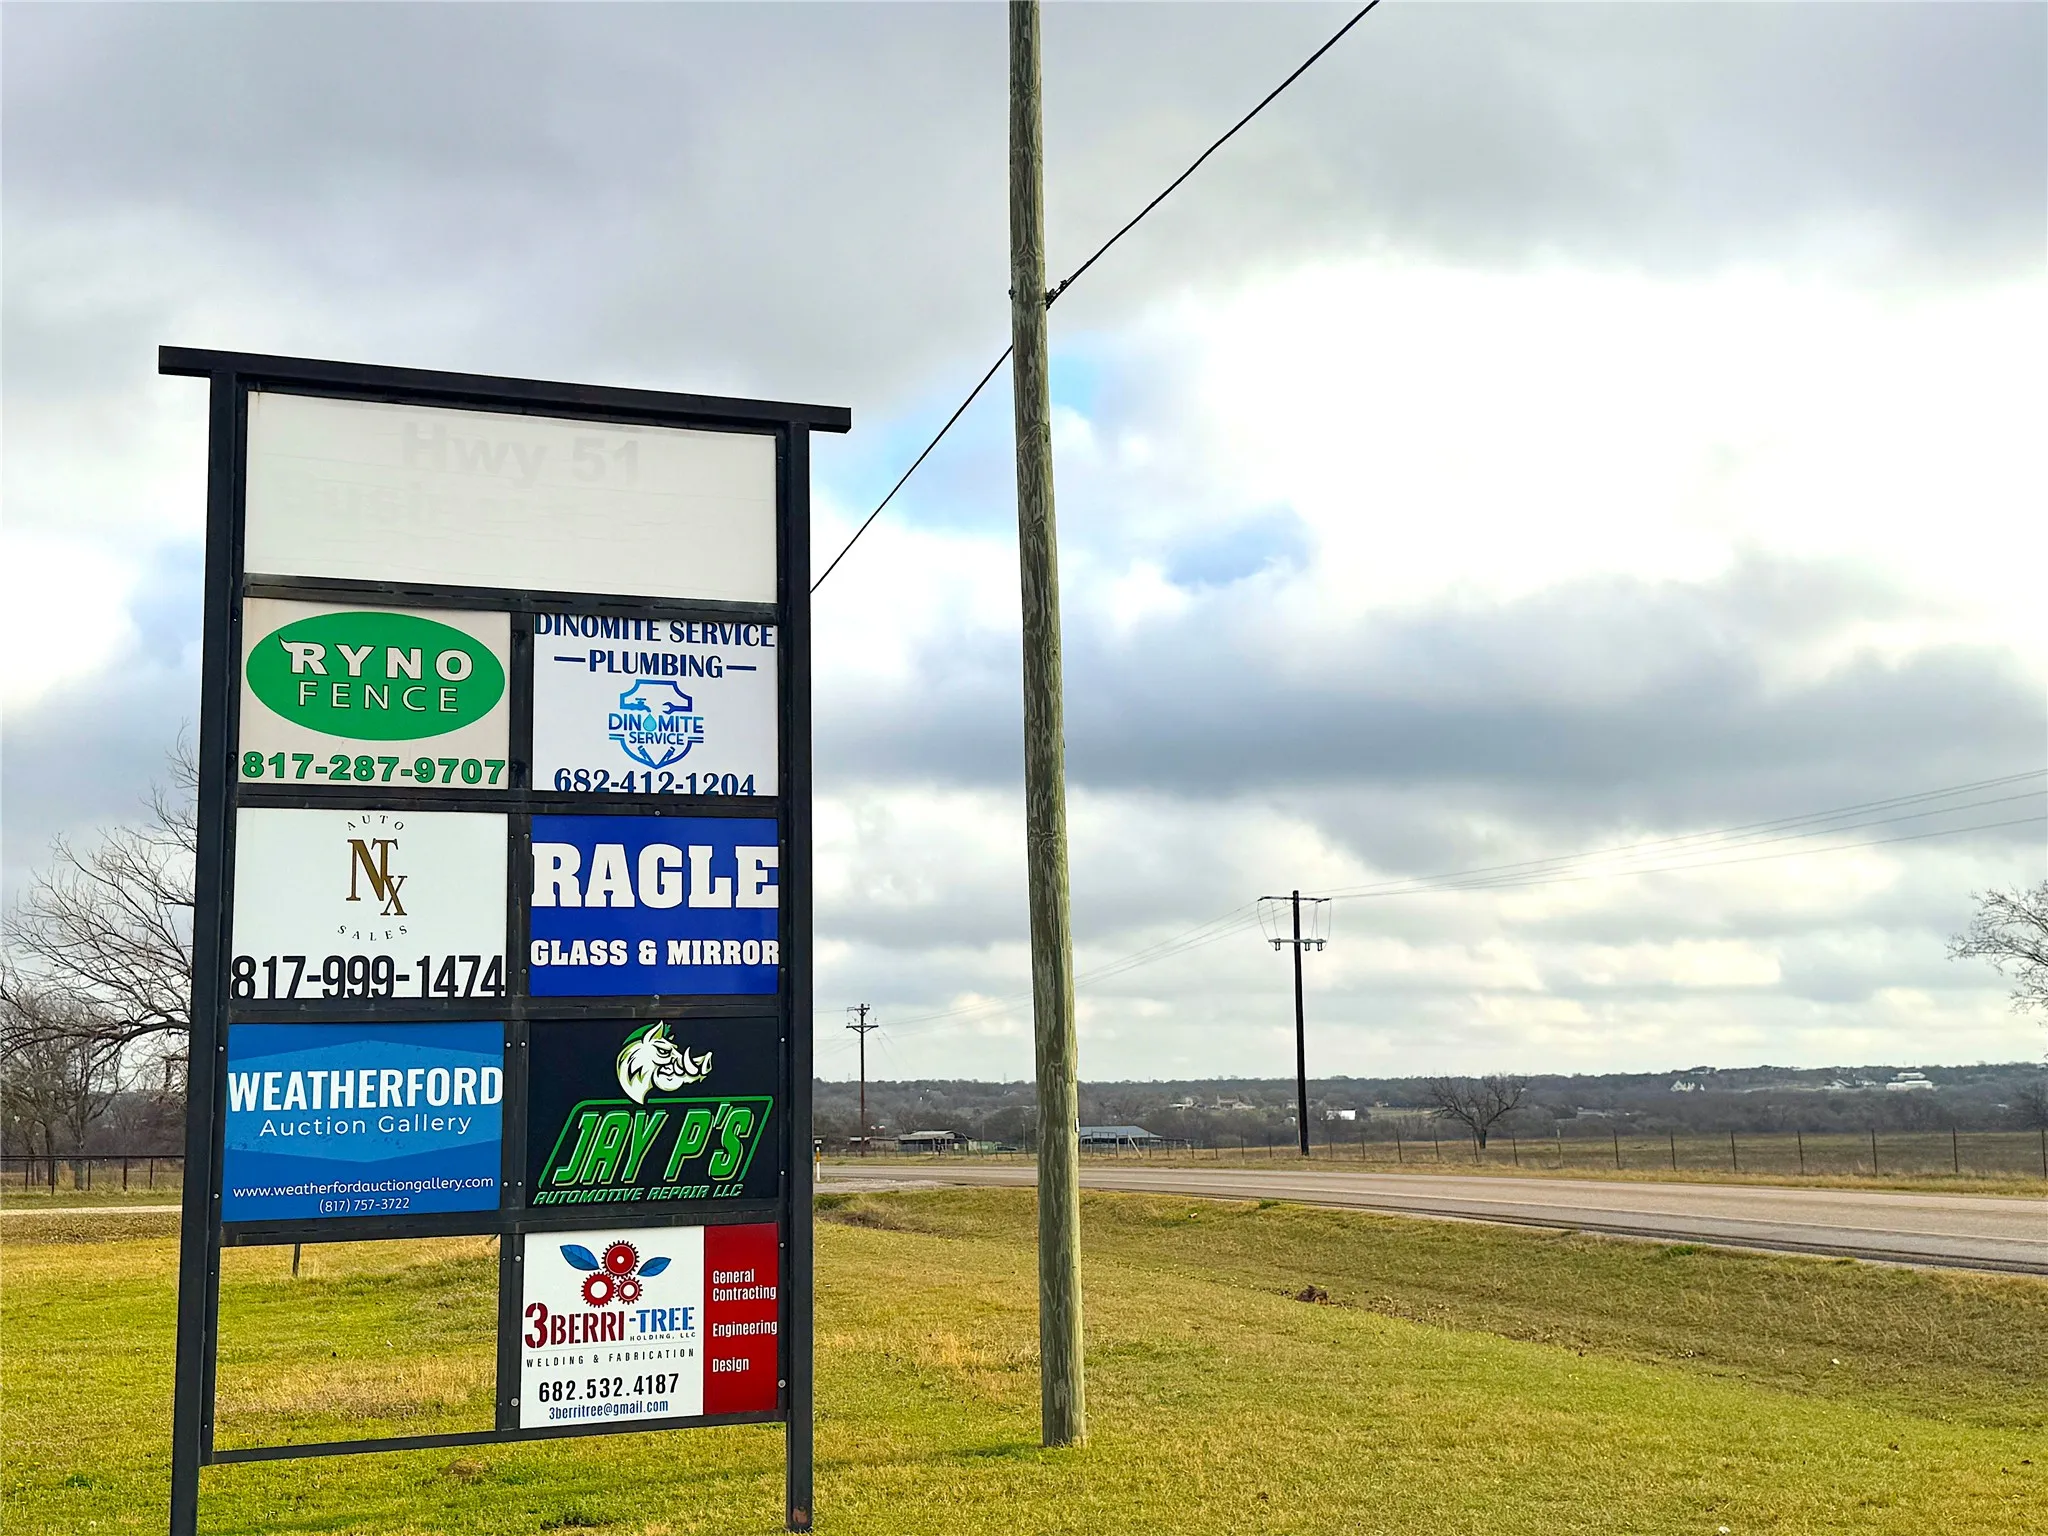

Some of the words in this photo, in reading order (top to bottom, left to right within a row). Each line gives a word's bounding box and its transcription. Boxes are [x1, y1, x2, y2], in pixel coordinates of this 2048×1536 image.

[402, 421, 548, 488] Hwy
[572, 436, 640, 485] 51
[535, 612, 661, 642] DINOMITE
[669, 620, 775, 647] SERVICE
[278, 633, 473, 682] RYNO
[589, 649, 723, 678] PLUMBING
[299, 681, 458, 713] FENCE
[629, 732, 684, 745] SERVICE
[242, 751, 506, 785] 817-287-9707
[554, 768, 756, 796] 682-412-1204
[347, 814, 404, 831] AUTO
[531, 842, 779, 909] RAGLE
[337, 925, 408, 942] SALES
[530, 940, 628, 966] GLASS
[638, 940, 657, 966] &
[667, 940, 779, 966] MIRROR
[231, 955, 505, 1000] 817-999-1474
[228, 1066, 504, 1112] WEATHERFORD
[259, 1117, 366, 1137] Auction
[378, 1113, 472, 1135] Gallery
[552, 1110, 669, 1186] JAY
[233, 1177, 494, 1198] www.weatherfordauctiongallery.com
[532, 1188, 645, 1205] AUTOMOTIVE
[646, 1185, 710, 1201] REPAIR
[713, 1184, 744, 1198] LLC
[319, 1199, 351, 1214] (817)
[354, 1198, 410, 1211] 757-3722
[712, 1269, 755, 1284] General
[712, 1286, 777, 1302] Contracting
[680, 1331, 697, 1339] LLC
[712, 1320, 778, 1338] Engineering
[526, 1355, 584, 1368] WELDING
[593, 1355, 600, 1364] &
[608, 1348, 695, 1363] FABRICATION
[712, 1358, 750, 1373] Design
[538, 1373, 680, 1402] 682.532.4187
[549, 1399, 669, 1420] 3berritree@gmail.com
